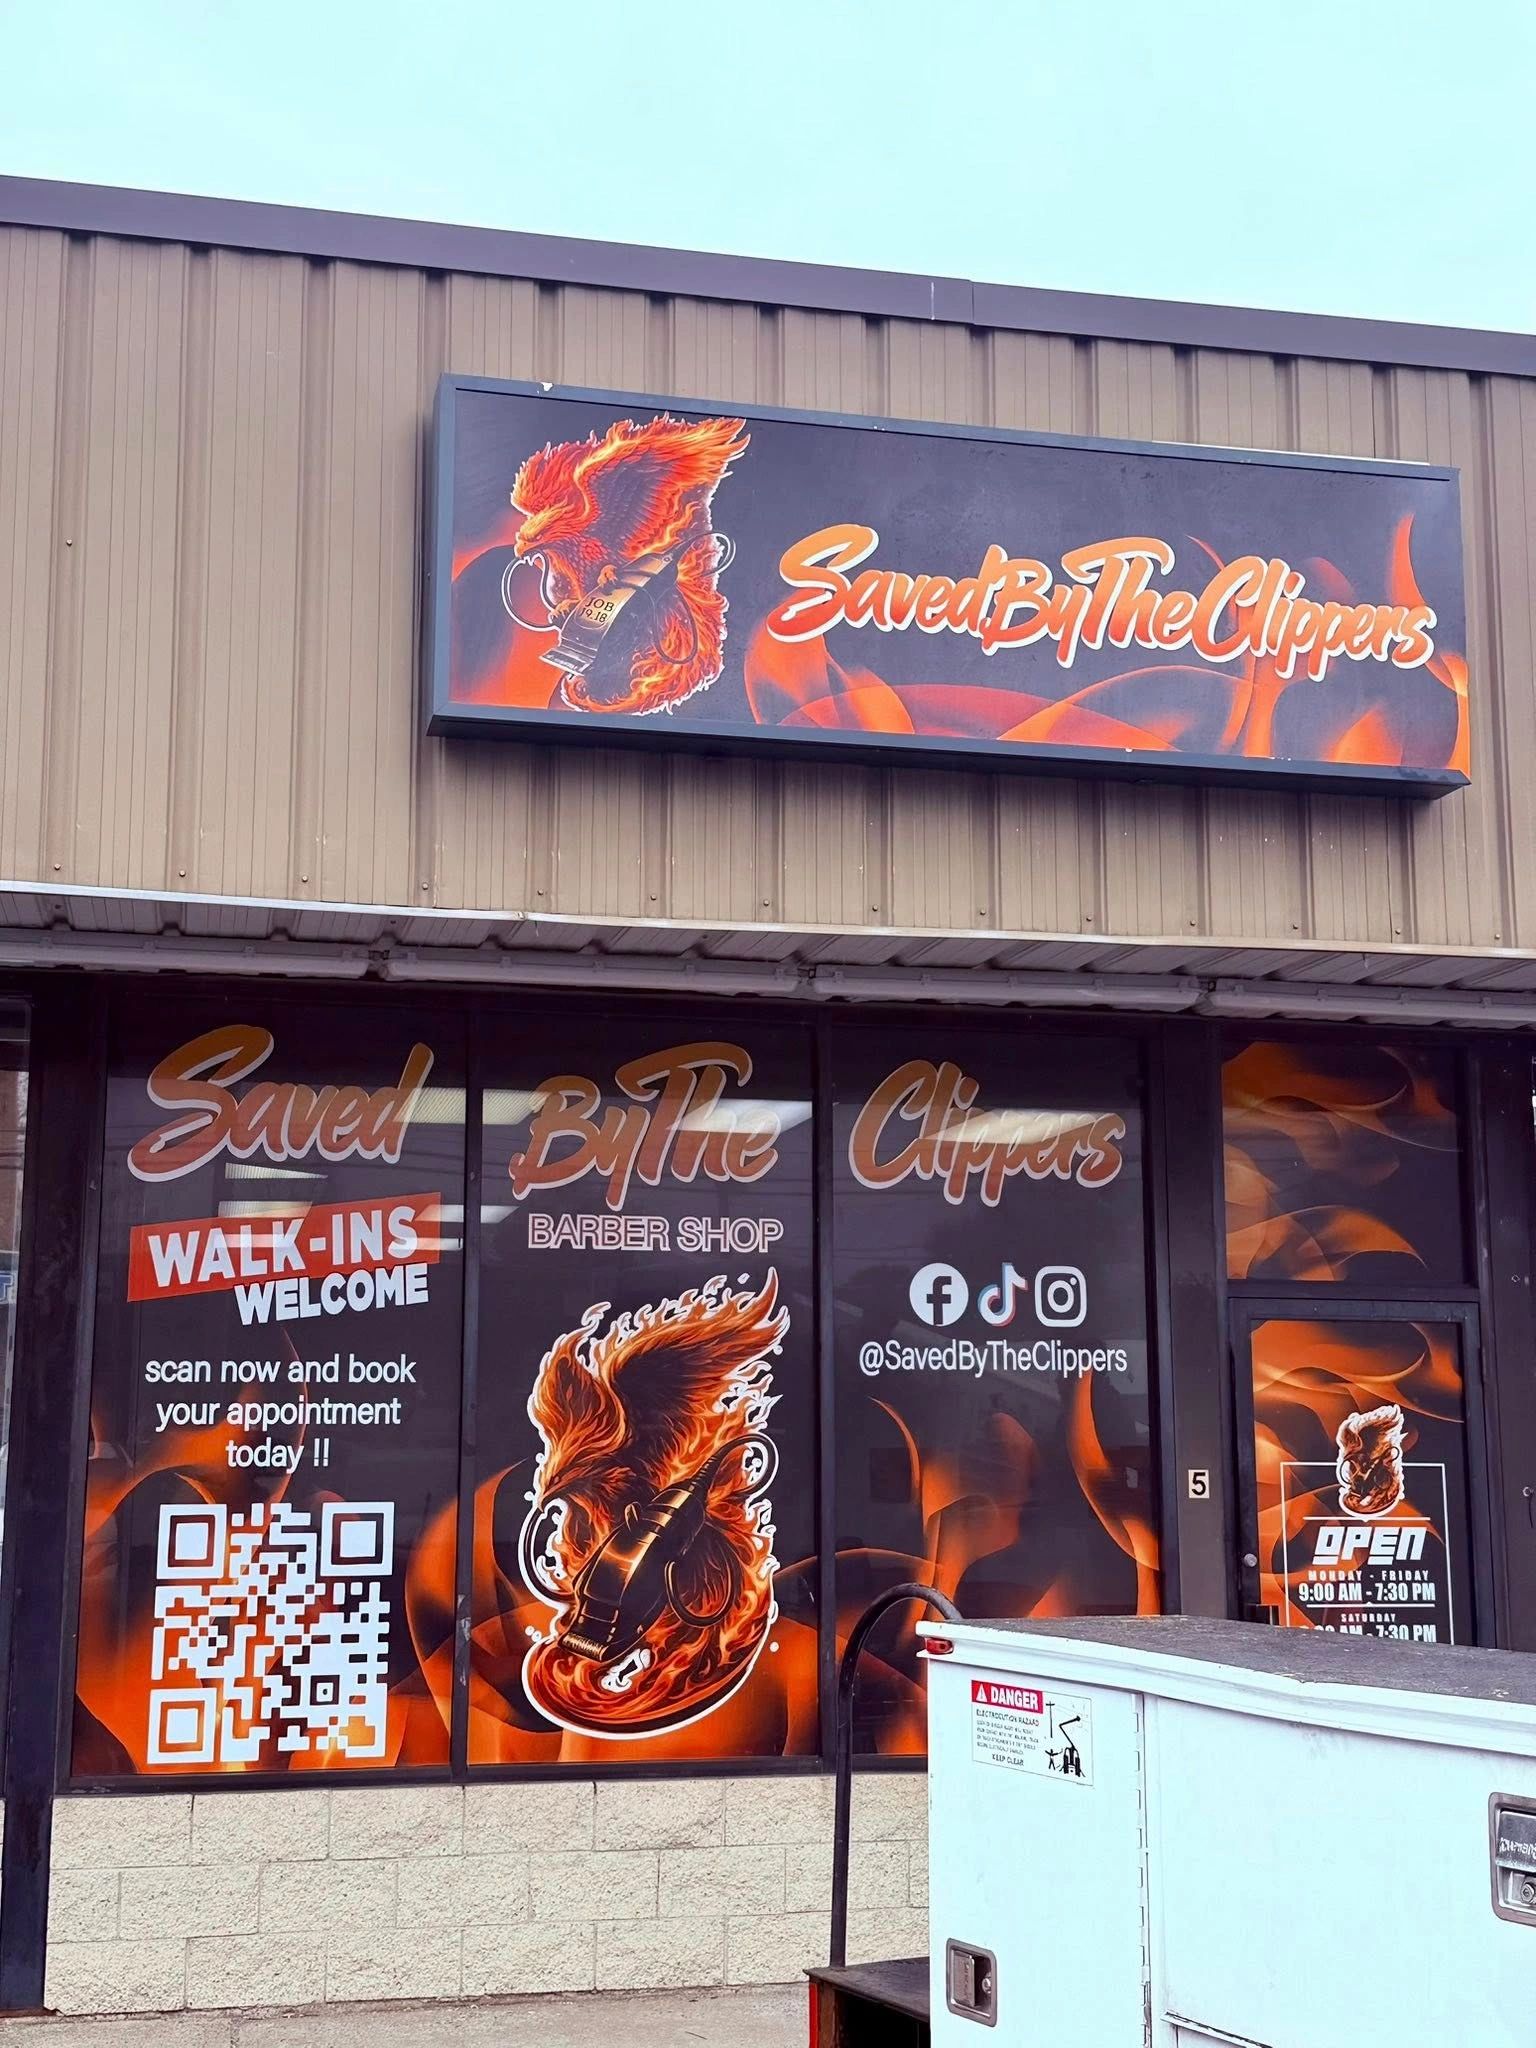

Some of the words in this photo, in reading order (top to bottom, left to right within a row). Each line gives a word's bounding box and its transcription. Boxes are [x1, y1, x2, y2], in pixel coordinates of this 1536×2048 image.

[580, 607, 608, 623] 19.18
[585, 597, 614, 612] JOB
[127, 1024, 434, 1182] Saved
[848, 1059, 1126, 1207] Clippers
[148, 1206, 419, 1287] WALK-INS
[528, 1213, 671, 1252] BARBER
[677, 1216, 784, 1253] SHOP
[234, 1263, 429, 1325] WELCOME
[144, 1359, 212, 1384] scan
[221, 1360, 281, 1383] now
[288, 1353, 340, 1383] and
[348, 1354, 416, 1384] book
[859, 1339, 1128, 1378] @SavedByTheClippers
[155, 1399, 220, 1432] your
[227, 1395, 402, 1432] appointment
[226, 1438, 304, 1474] today
[1191, 1472, 1206, 1496] 5
[1312, 1526, 1427, 1565] OPEN
[1308, 1570, 1362, 1581] MONDAY
[1382, 1570, 1429, 1581] FRIDAY
[1298, 1583, 1335, 1602] 9:00
[1338, 1583, 1363, 1601] AM
[1375, 1583, 1408, 1601] 7:30
[1412, 1583, 1436, 1601] PM
[1341, 1613, 1396, 1622] SATURDAY
[1413, 1625, 1437, 1643] PM
[990, 1685, 1039, 1711] DANGER
